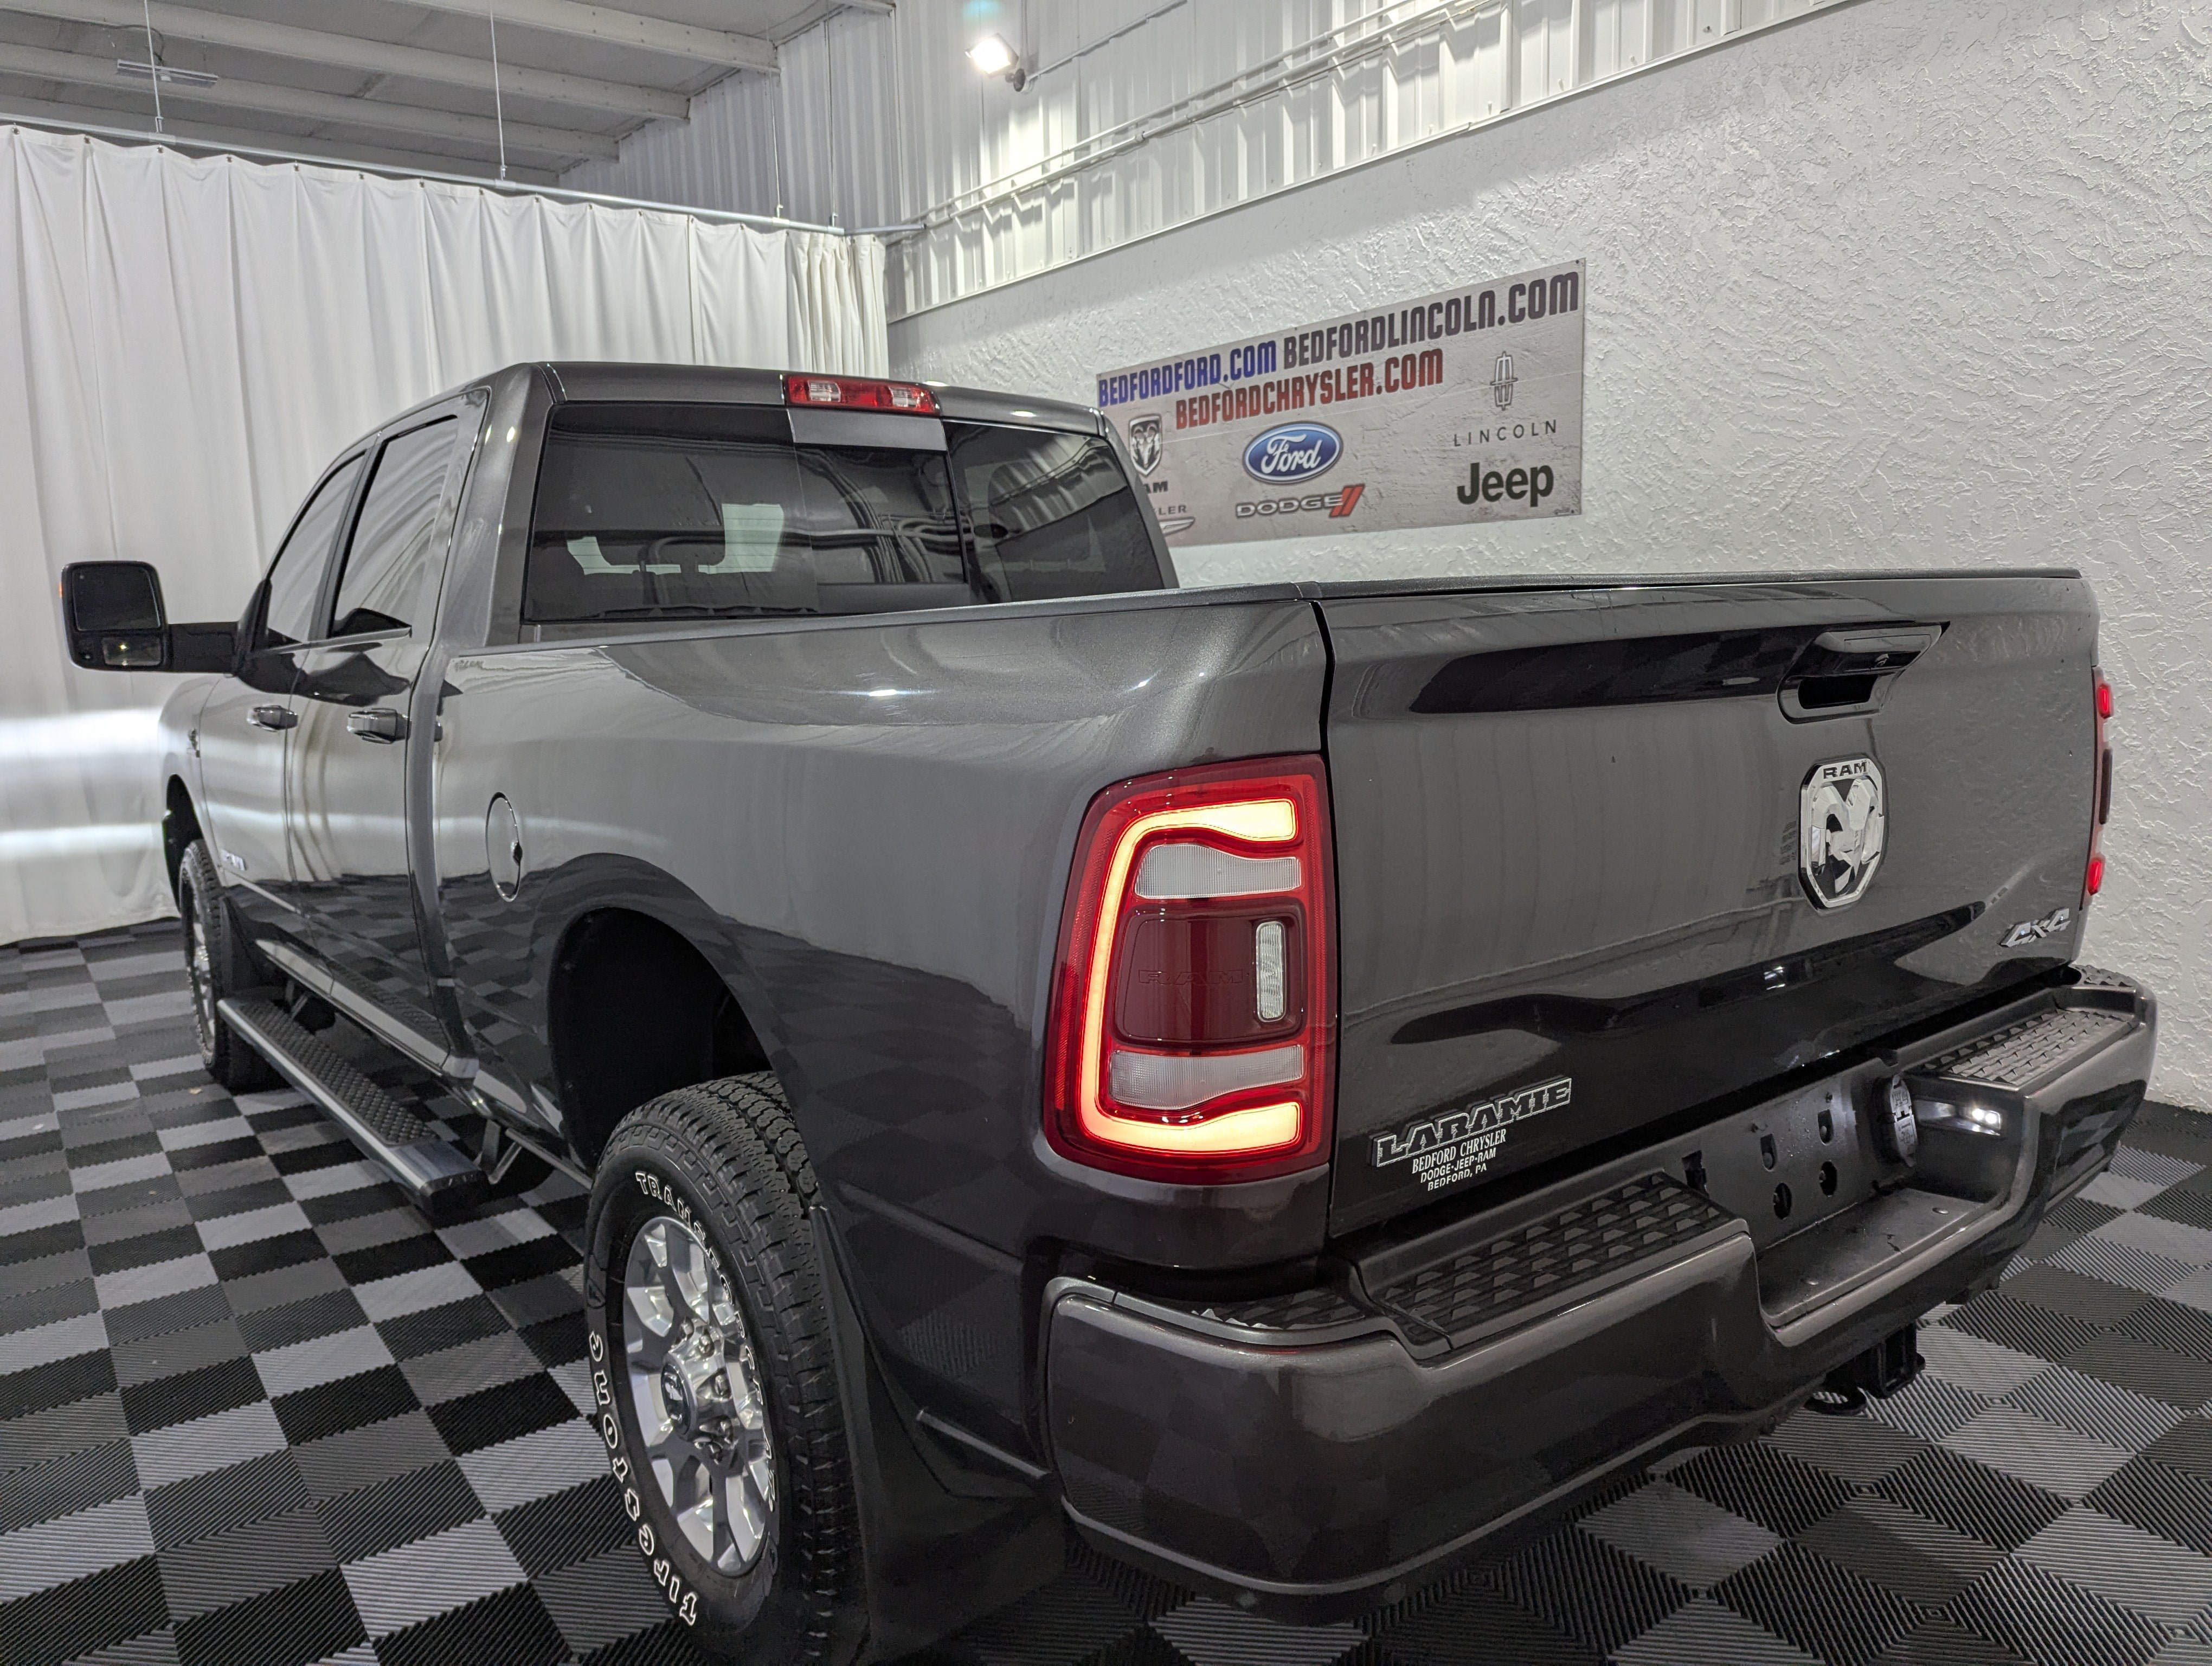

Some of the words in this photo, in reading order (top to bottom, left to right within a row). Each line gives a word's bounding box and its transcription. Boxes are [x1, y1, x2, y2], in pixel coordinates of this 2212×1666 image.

[1099, 340, 1277, 408] BEDFORDFORD.COM
[1284, 271, 1579, 369] BEDFORDLINCOLN.COM
[1176, 348, 1443, 430] BEDFORDCHRYSLER.COM
[1454, 419, 1556, 447] LINCOLN
[1261, 434, 1323, 474] Ford
[1457, 462, 1554, 507] Jeep
[1236, 492, 1343, 518] DODGE
[1823, 761, 1869, 779] RAM
[1139, 969, 1243, 985] RAM
[1373, 1076, 1572, 1167] LARAMIE
[1412, 1146, 1456, 1174] BEDFORD
[1460, 1129, 1507, 1157] CHRYSLER
[1427, 1168, 1473, 1191] BEDFORD,
[1475, 1163, 1487, 1174] PA
